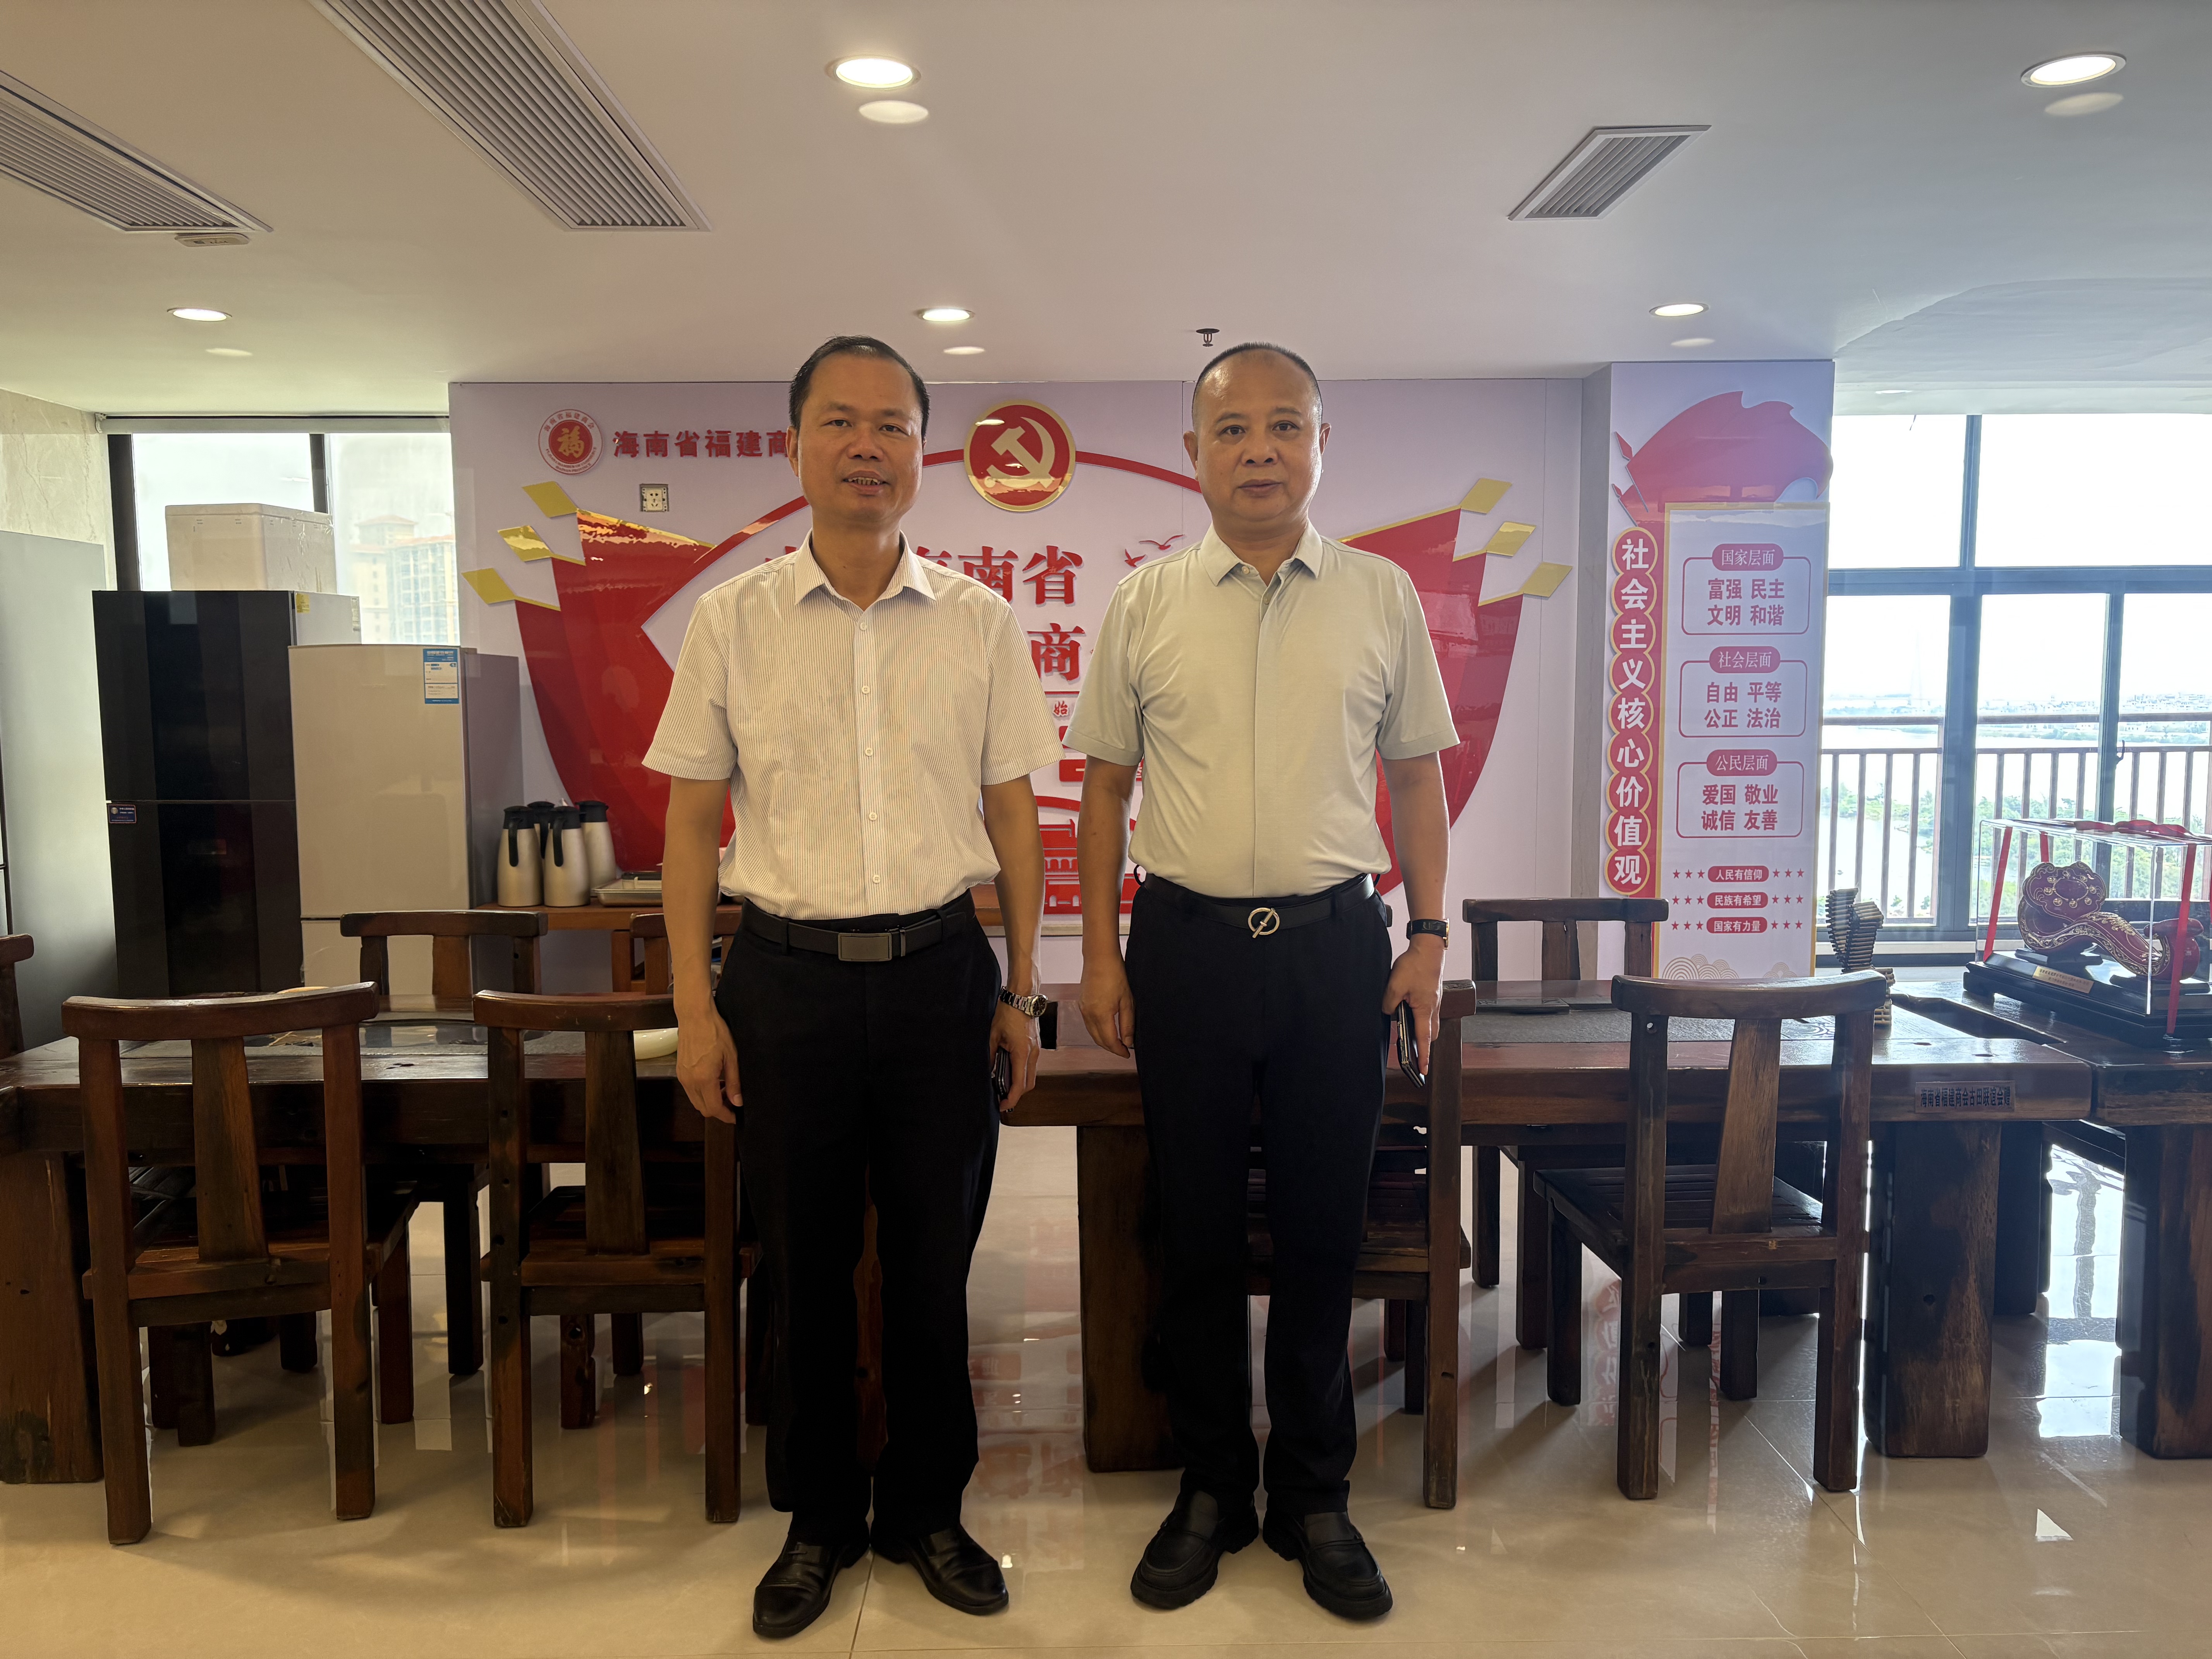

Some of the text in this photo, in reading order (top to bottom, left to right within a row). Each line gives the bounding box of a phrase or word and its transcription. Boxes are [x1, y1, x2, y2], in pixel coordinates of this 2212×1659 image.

[557, 426, 584, 458] 福
[613, 429, 788, 458] 海南省福建商
[1722, 549, 1775, 566] 国家层面
[916, 545, 1084, 605] 南省
[1708, 578, 1785, 600] 富强 民主
[1707, 604, 1784, 626] 文明 和谐
[1719, 651, 1772, 668] 社会层面
[1707, 681, 1782, 703] 自由 平等
[1053, 701, 1068, 715] 始
[1613, 539, 1649, 885] 社会主义核心价值观
[1704, 707, 1781, 728] 公正 法治
[1716, 754, 1769, 771] 公民层面
[1702, 784, 1778, 805] 爱国 敬业
[1701, 809, 1778, 831] 诚信 友善
[1716, 869, 1762, 880] 人民有信仰
[1715, 895, 1761, 906] 民族有希望
[1714, 920, 1760, 932] 国家有力量
